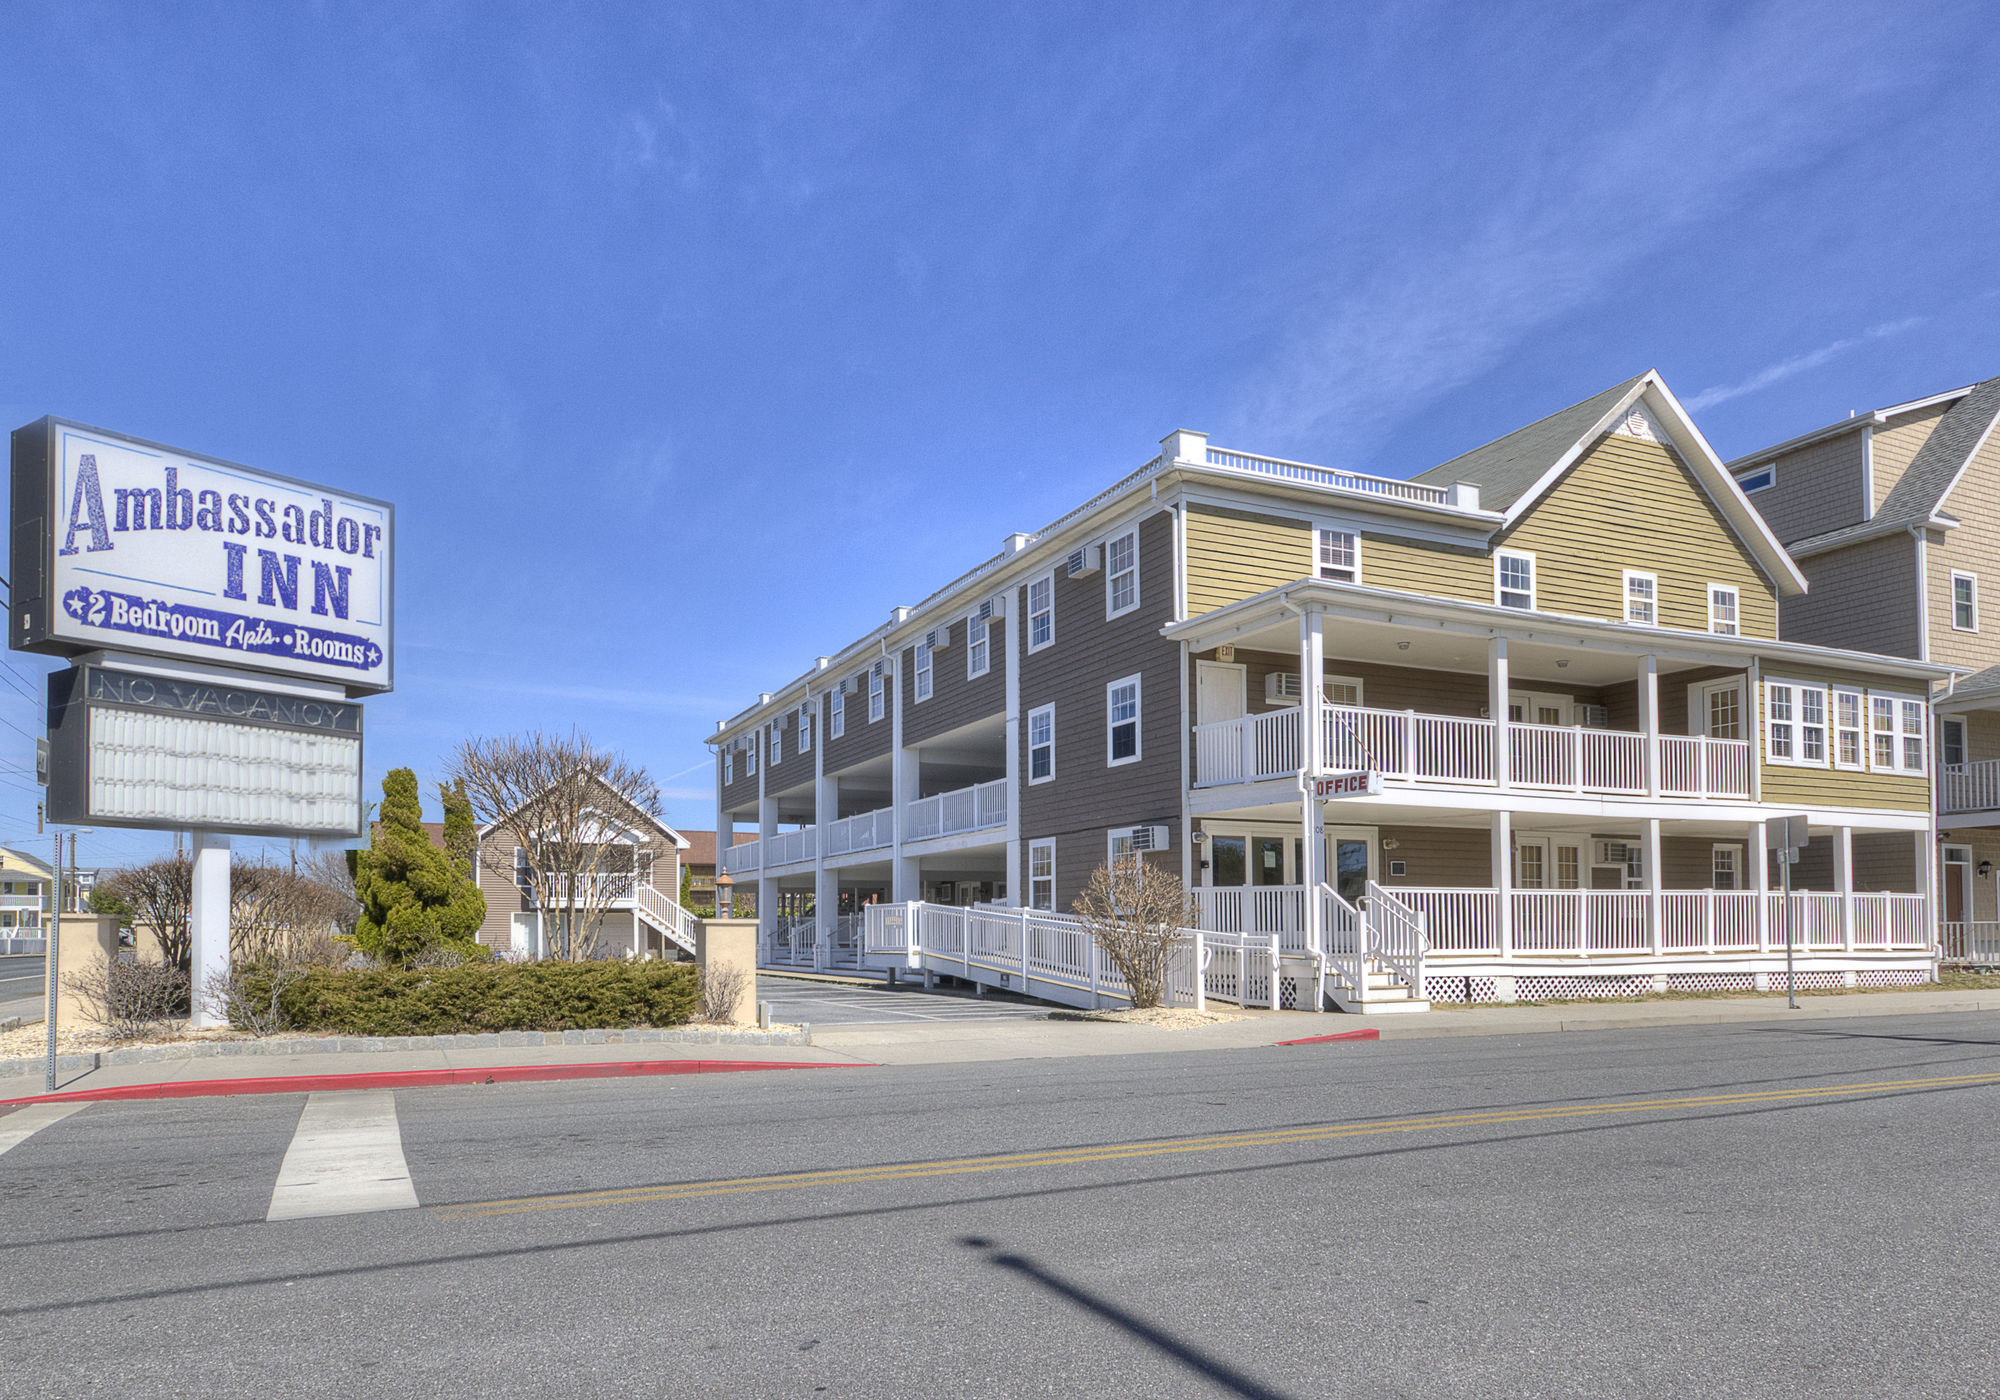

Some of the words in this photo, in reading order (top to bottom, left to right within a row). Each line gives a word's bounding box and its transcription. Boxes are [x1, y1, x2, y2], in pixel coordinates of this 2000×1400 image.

[59, 454, 382, 560] Ambassador
[223, 541, 352, 620] INN
[88, 594, 106, 626] 2
[110, 595, 221, 641] Bedroom
[294, 628, 365, 664] Rooms
[1221, 646, 1233, 657] EXIT
[95, 675, 156, 704] NO
[172, 682, 345, 730] VACANCY
[1316, 775, 1368, 796] OFFICE
